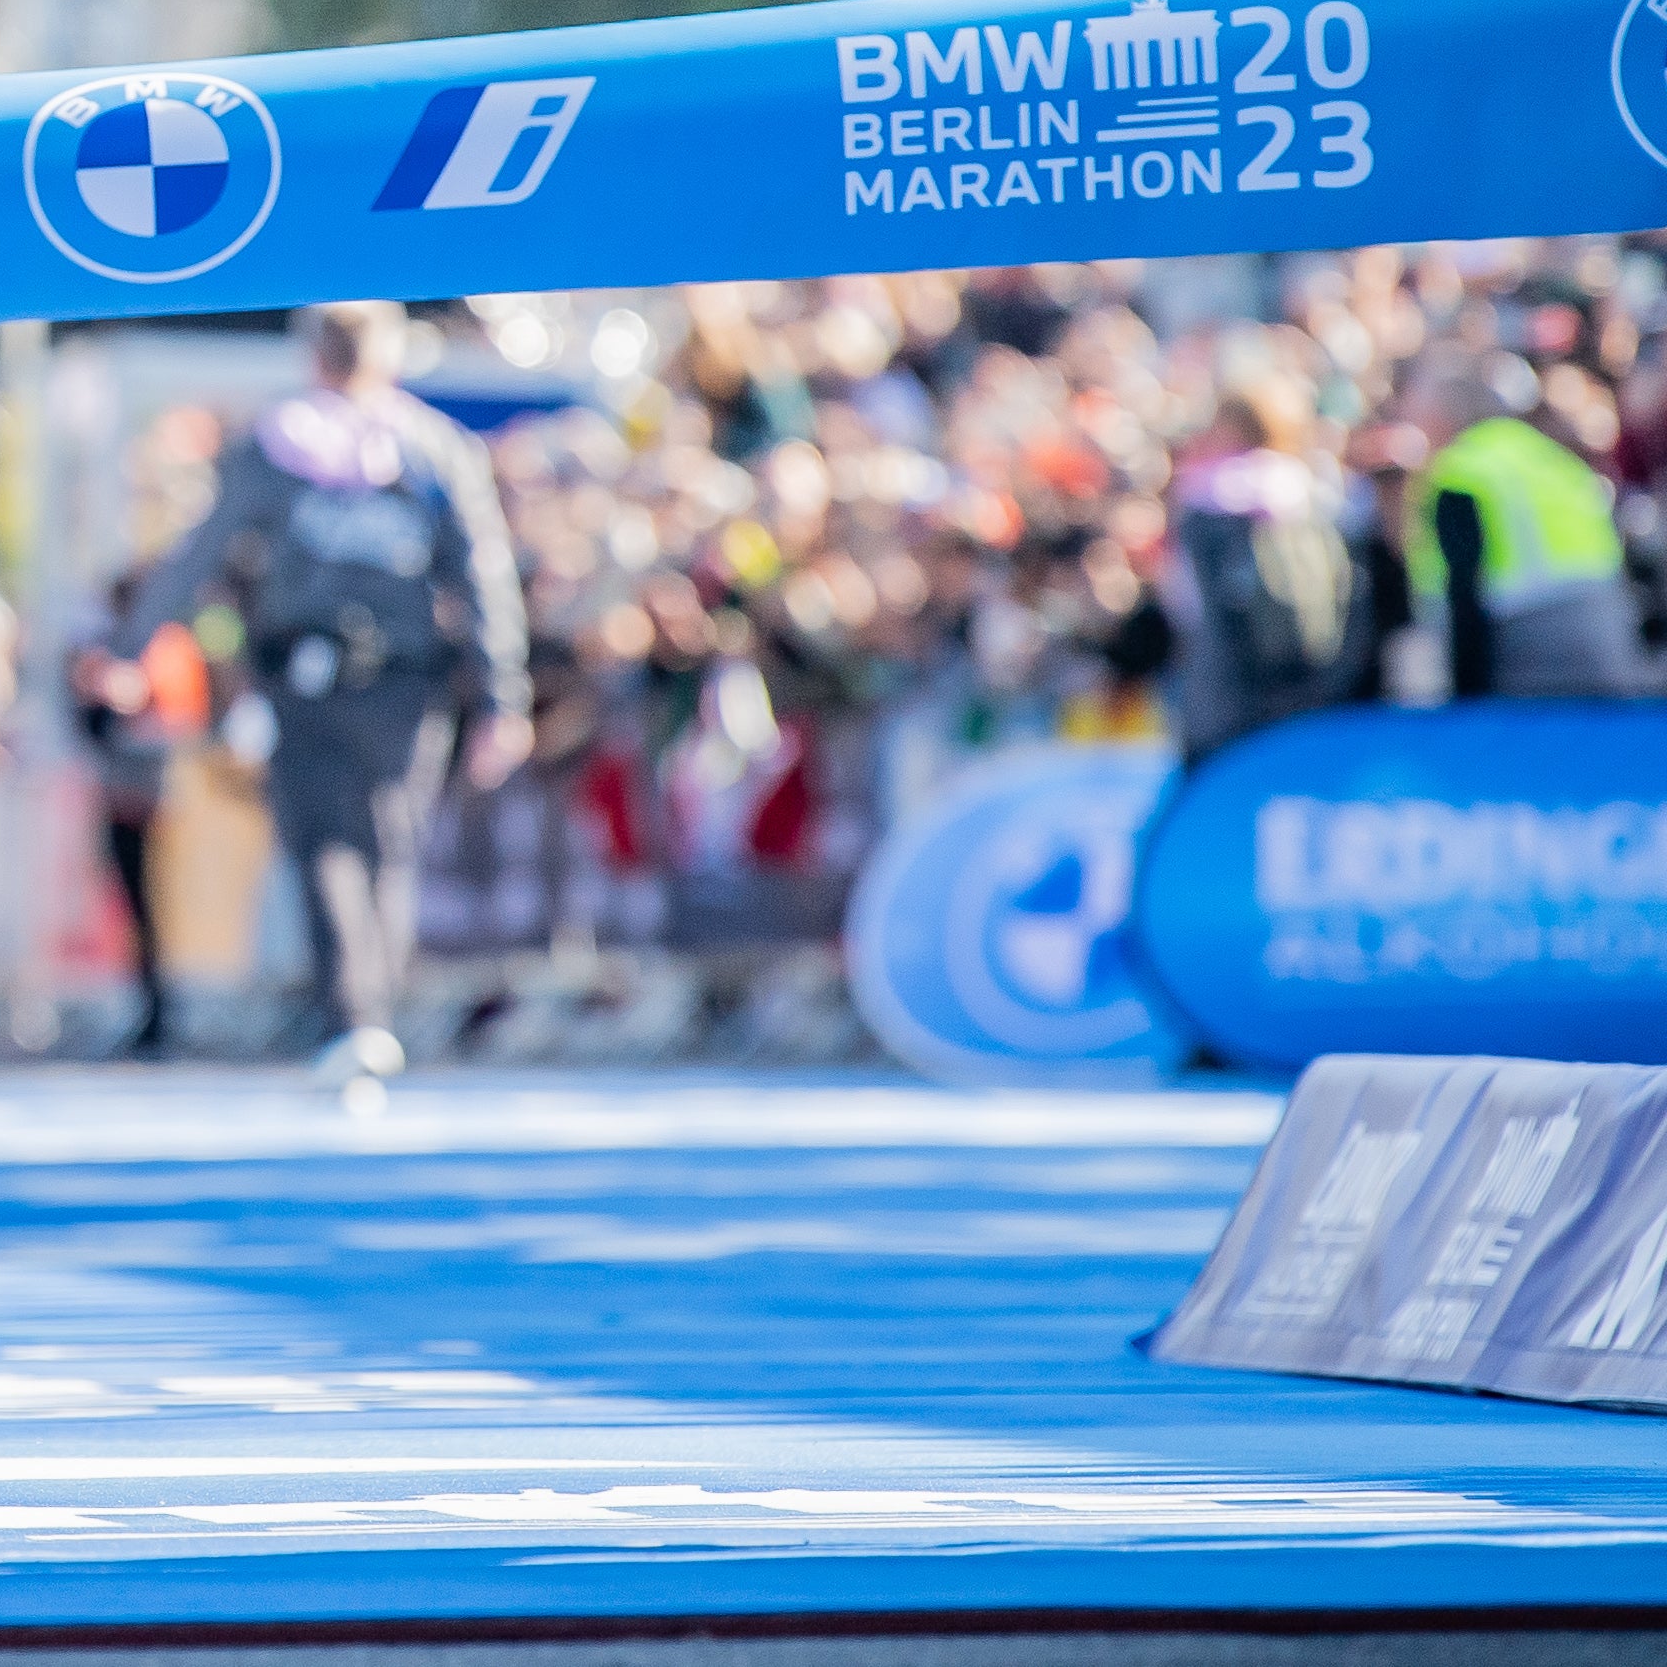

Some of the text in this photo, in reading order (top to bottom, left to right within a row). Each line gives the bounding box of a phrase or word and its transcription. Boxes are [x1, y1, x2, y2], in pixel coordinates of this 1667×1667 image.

[836, 1, 1369, 103] BMW 20
[55, 77, 245, 132] BMW
[844, 102, 1374, 191] BERLIN 23
[846, 149, 1220, 214] MARATHON
